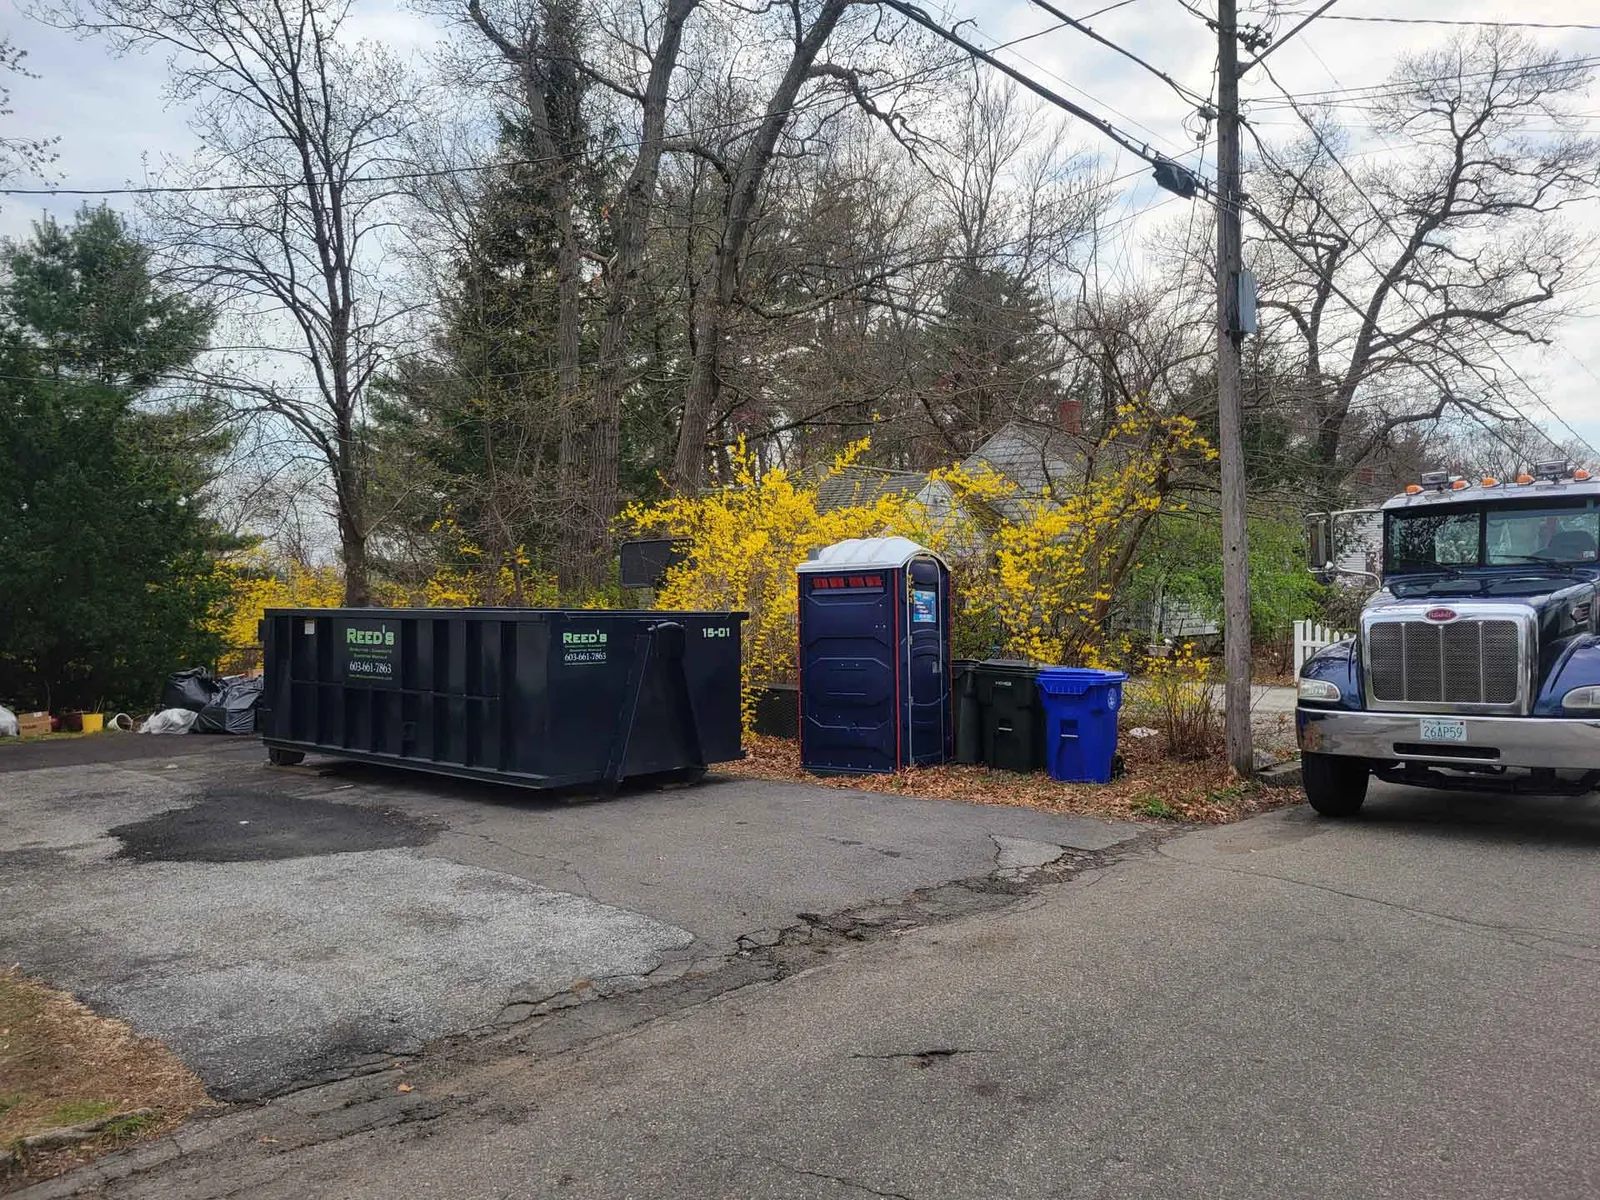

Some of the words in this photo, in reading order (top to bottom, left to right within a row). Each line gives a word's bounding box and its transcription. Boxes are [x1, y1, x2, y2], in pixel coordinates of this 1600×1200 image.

[347, 624, 395, 645] REED'S
[563, 629, 607, 643] REED'S
[702, 627, 730, 638] 15-01
